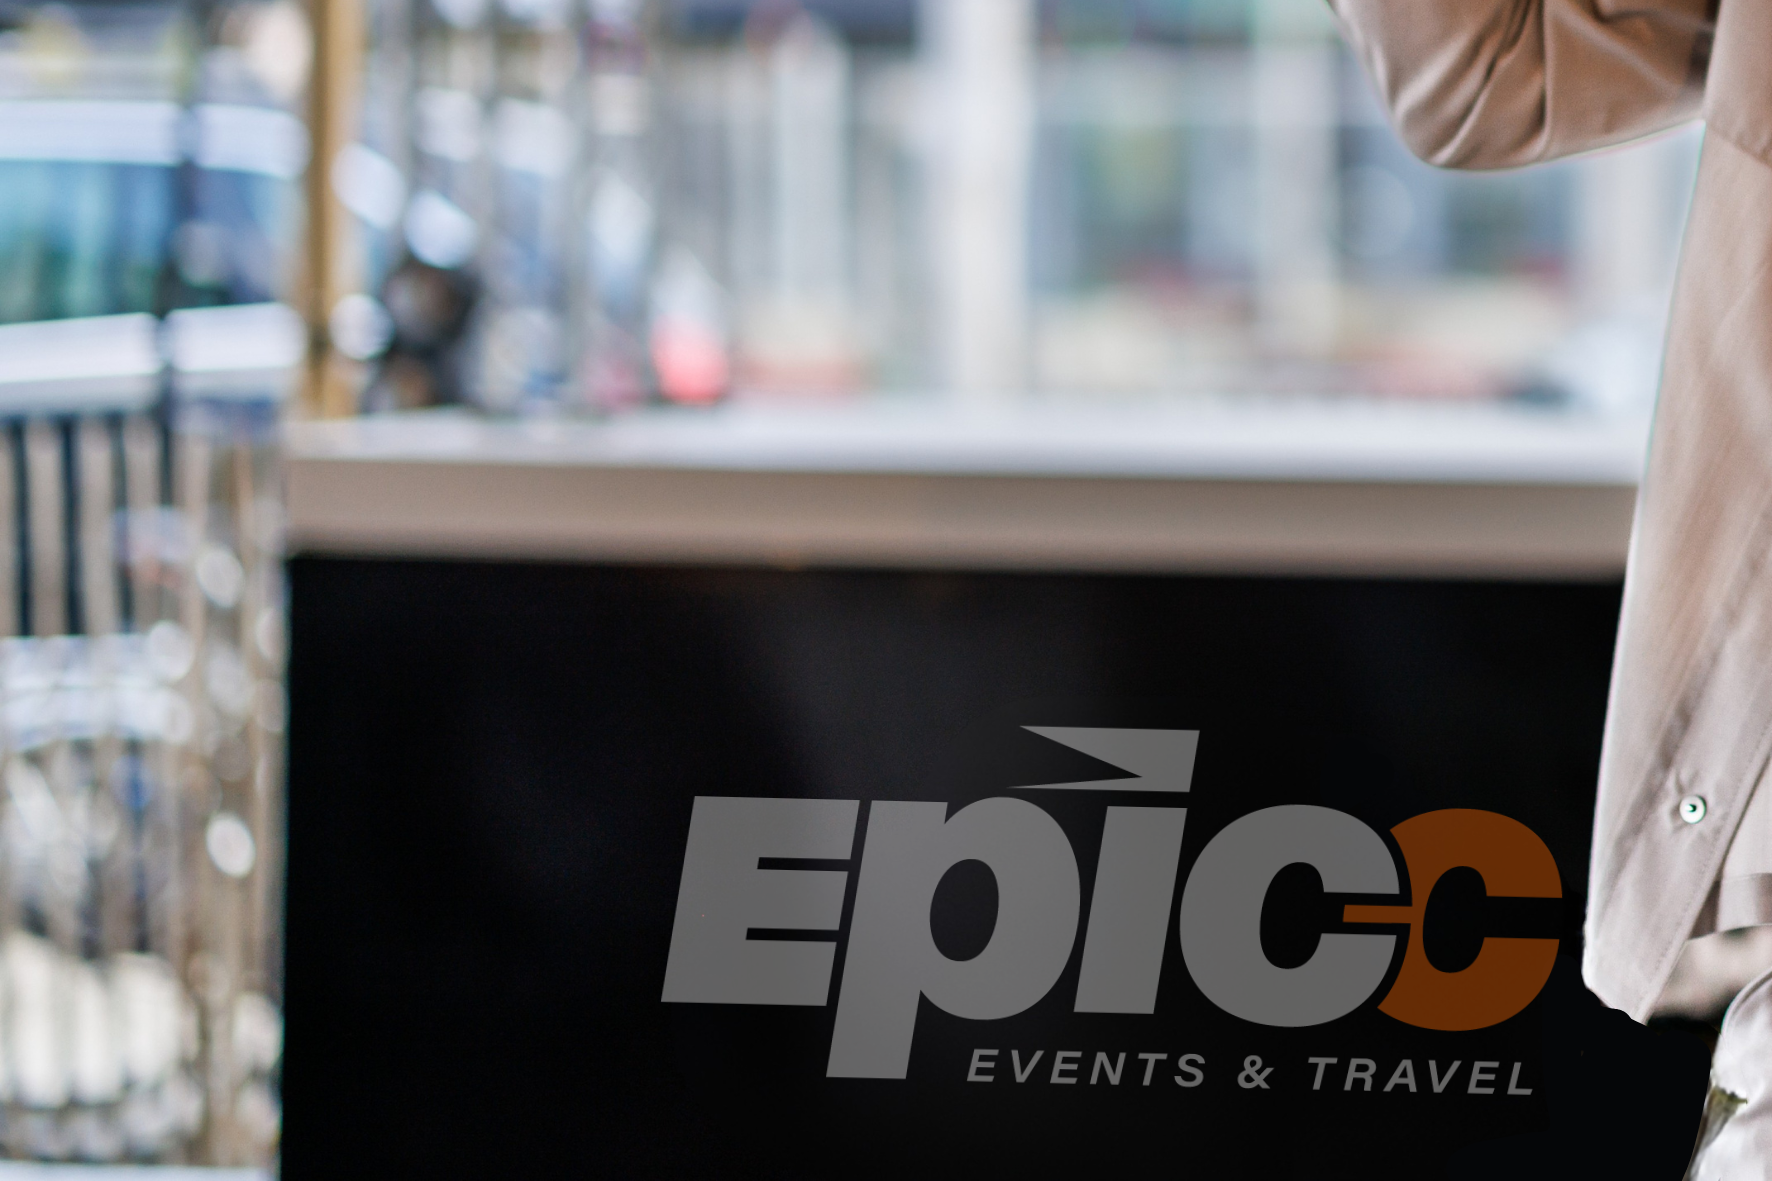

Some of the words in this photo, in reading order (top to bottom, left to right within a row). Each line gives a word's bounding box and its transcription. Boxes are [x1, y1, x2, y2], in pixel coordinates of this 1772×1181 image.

[966, 1048, 1206, 1088] EVENTS
[1237, 1054, 1275, 1089] &
[1307, 1056, 1534, 1096] TRAVEL
